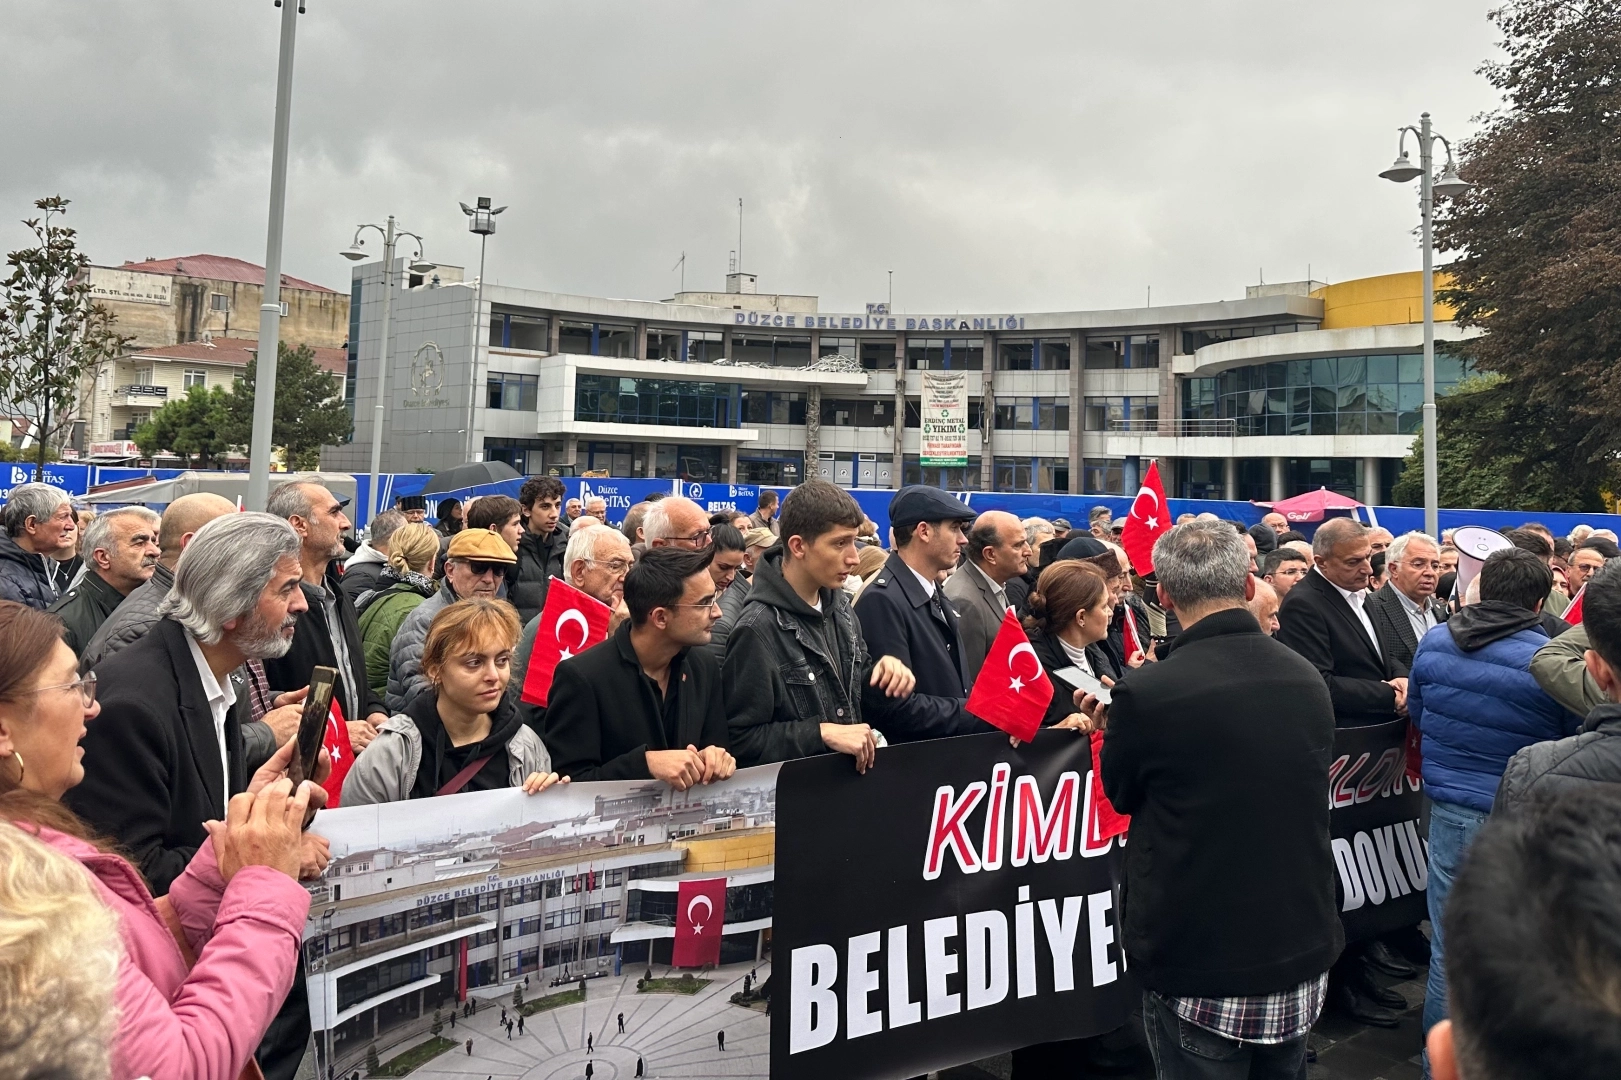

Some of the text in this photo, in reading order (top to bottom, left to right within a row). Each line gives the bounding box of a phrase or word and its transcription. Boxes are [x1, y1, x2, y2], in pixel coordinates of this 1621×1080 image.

[867, 303, 889, 314] T.C.
[735, 312, 1024, 332] DÜZCE BELEDİYE BAŞKANLIĞI
[598, 486, 618, 494] Düzce
[416, 870, 565, 906] DÜZCE BELEDİYE BAŞKANLIĞI
[790, 884, 1127, 1055] BELEDİYE
